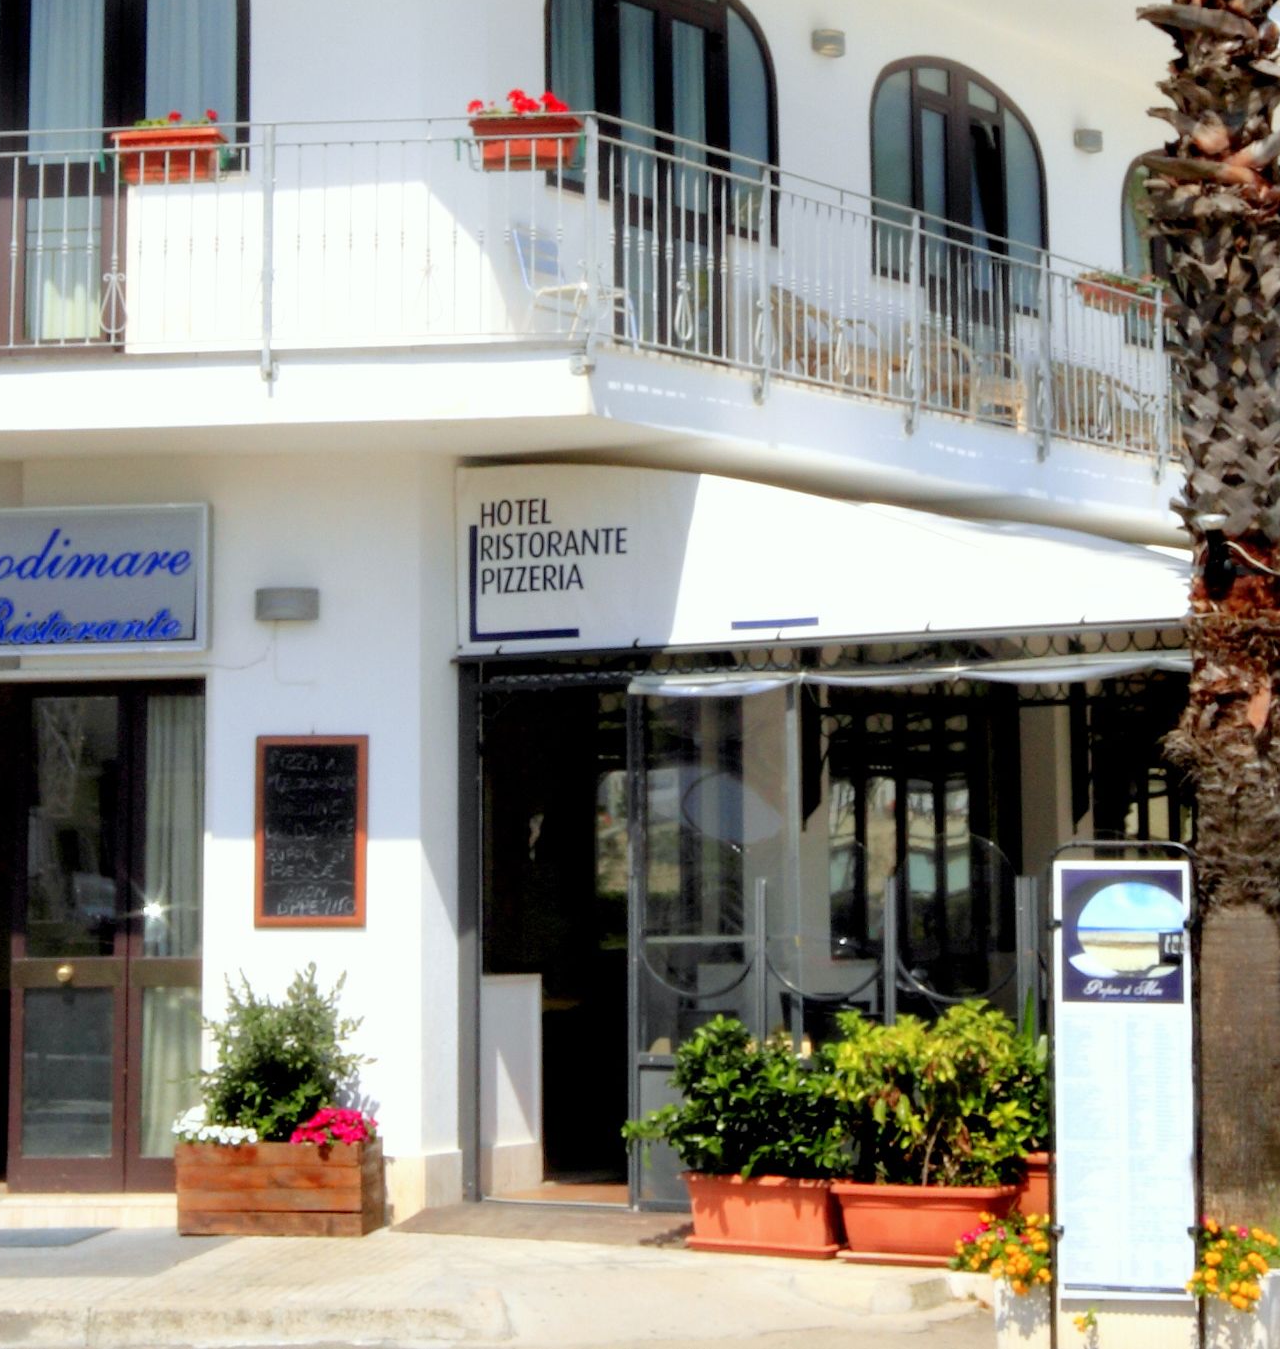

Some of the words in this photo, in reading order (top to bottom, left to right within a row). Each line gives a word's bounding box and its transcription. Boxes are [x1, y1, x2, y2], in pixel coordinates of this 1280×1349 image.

[479, 498, 552, 528] HOTEL
[479, 527, 628, 562] RISTORANTE
[481, 564, 584, 595] PIZZERIA
